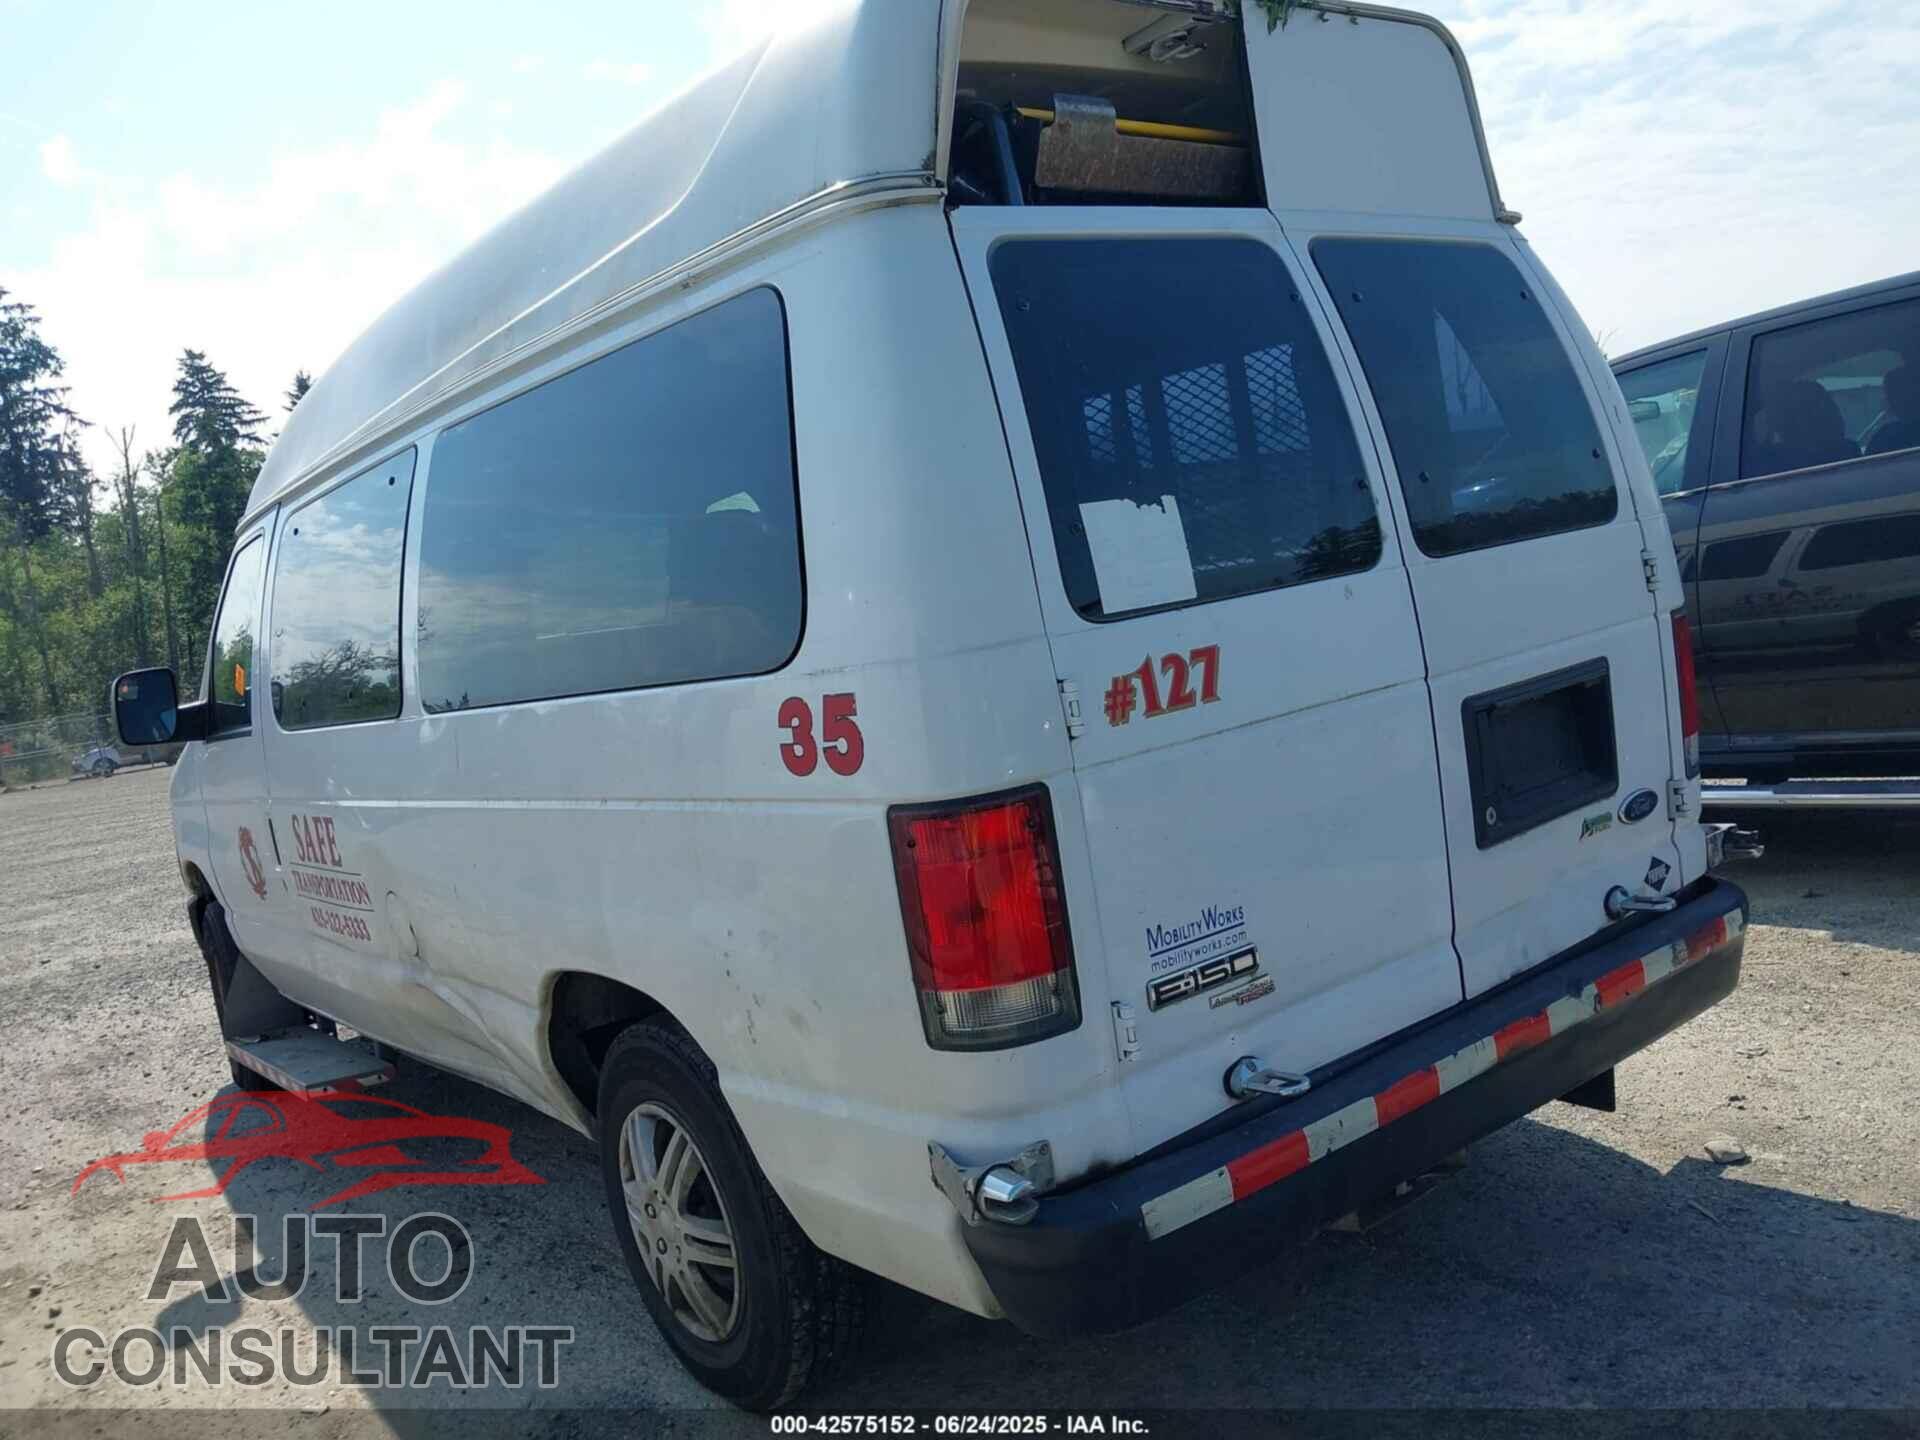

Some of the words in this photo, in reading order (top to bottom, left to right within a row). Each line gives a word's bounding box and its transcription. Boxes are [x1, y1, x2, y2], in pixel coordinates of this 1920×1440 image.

[1103, 643, 1221, 727] #127
[778, 692, 864, 777] 35
[292, 814, 343, 867] SAFE
[1151, 930, 1247, 972] mobilityworks.com
